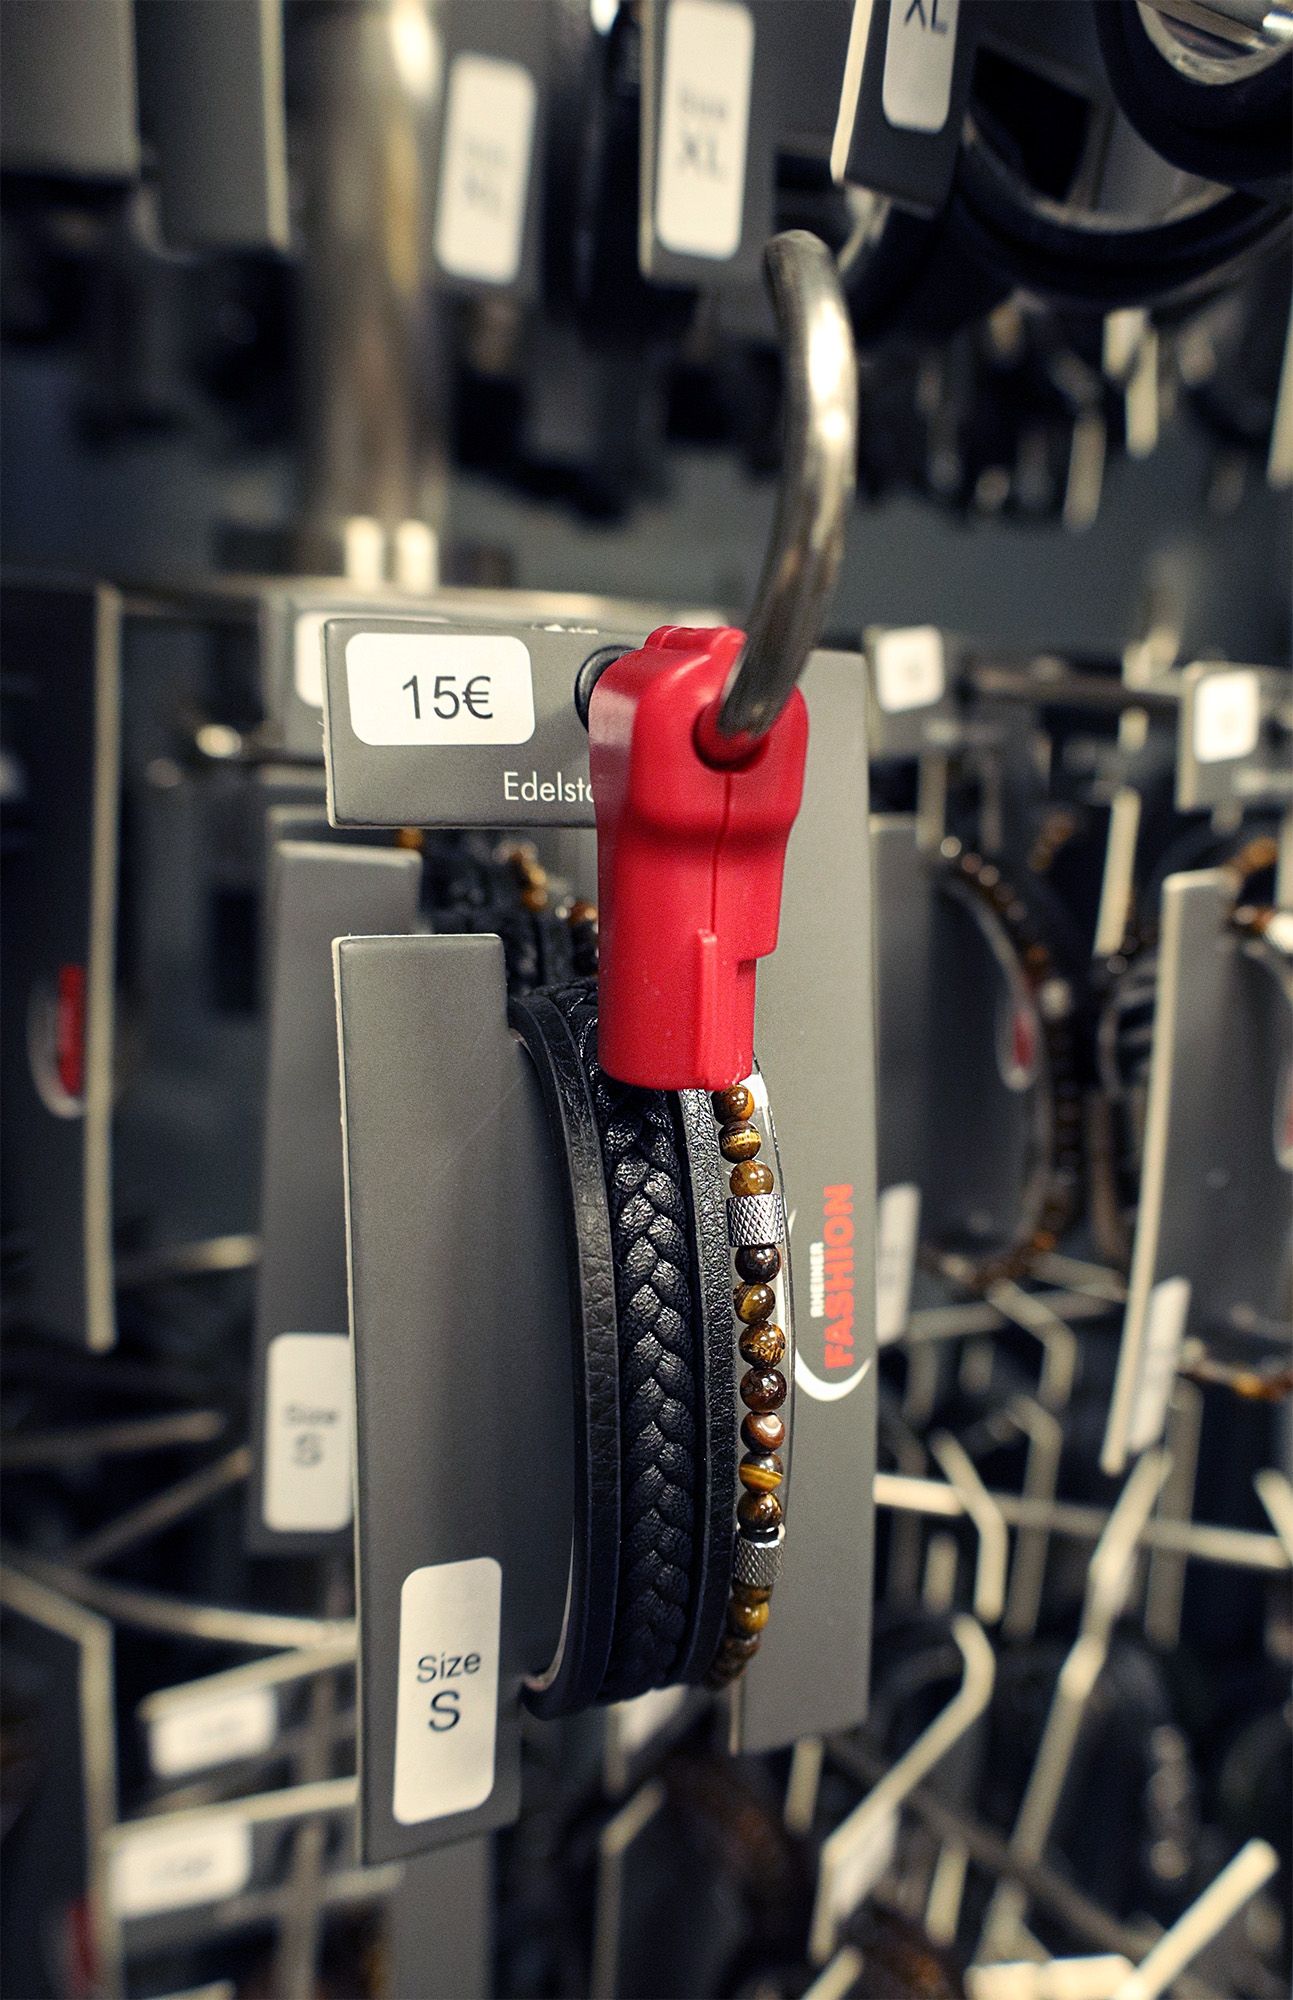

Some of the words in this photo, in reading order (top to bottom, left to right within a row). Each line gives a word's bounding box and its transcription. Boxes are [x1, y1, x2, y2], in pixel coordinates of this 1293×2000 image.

[402, 675, 494, 719] 15€
[823, 1183, 855, 1369] FASHION
[416, 1650, 482, 1683] Size
[428, 1690, 461, 1732] S
